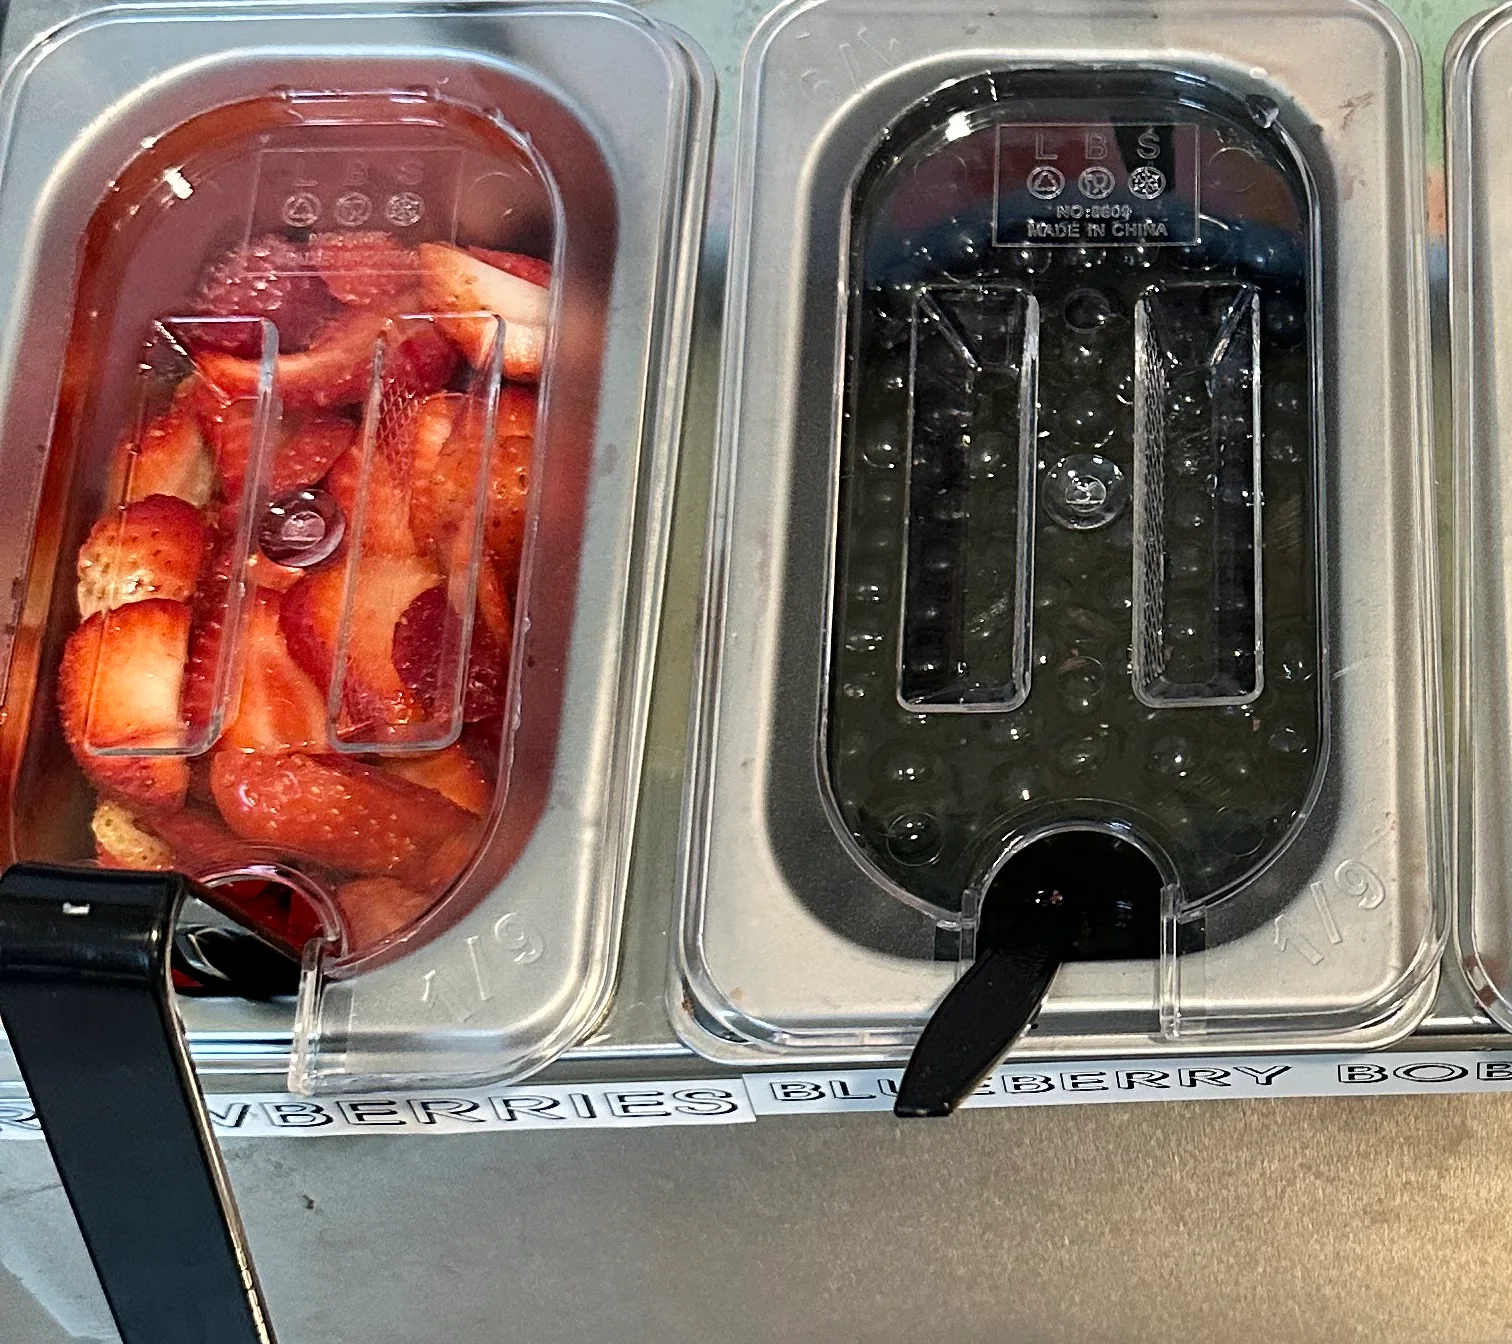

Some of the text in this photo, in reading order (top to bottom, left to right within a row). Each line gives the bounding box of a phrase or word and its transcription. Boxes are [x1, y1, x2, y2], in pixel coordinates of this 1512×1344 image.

[1026, 222, 1169, 238] MADE IN CHINA
[1273, 858, 1386, 966] 1/9
[769, 1064, 1293, 1102] BLBERRY
